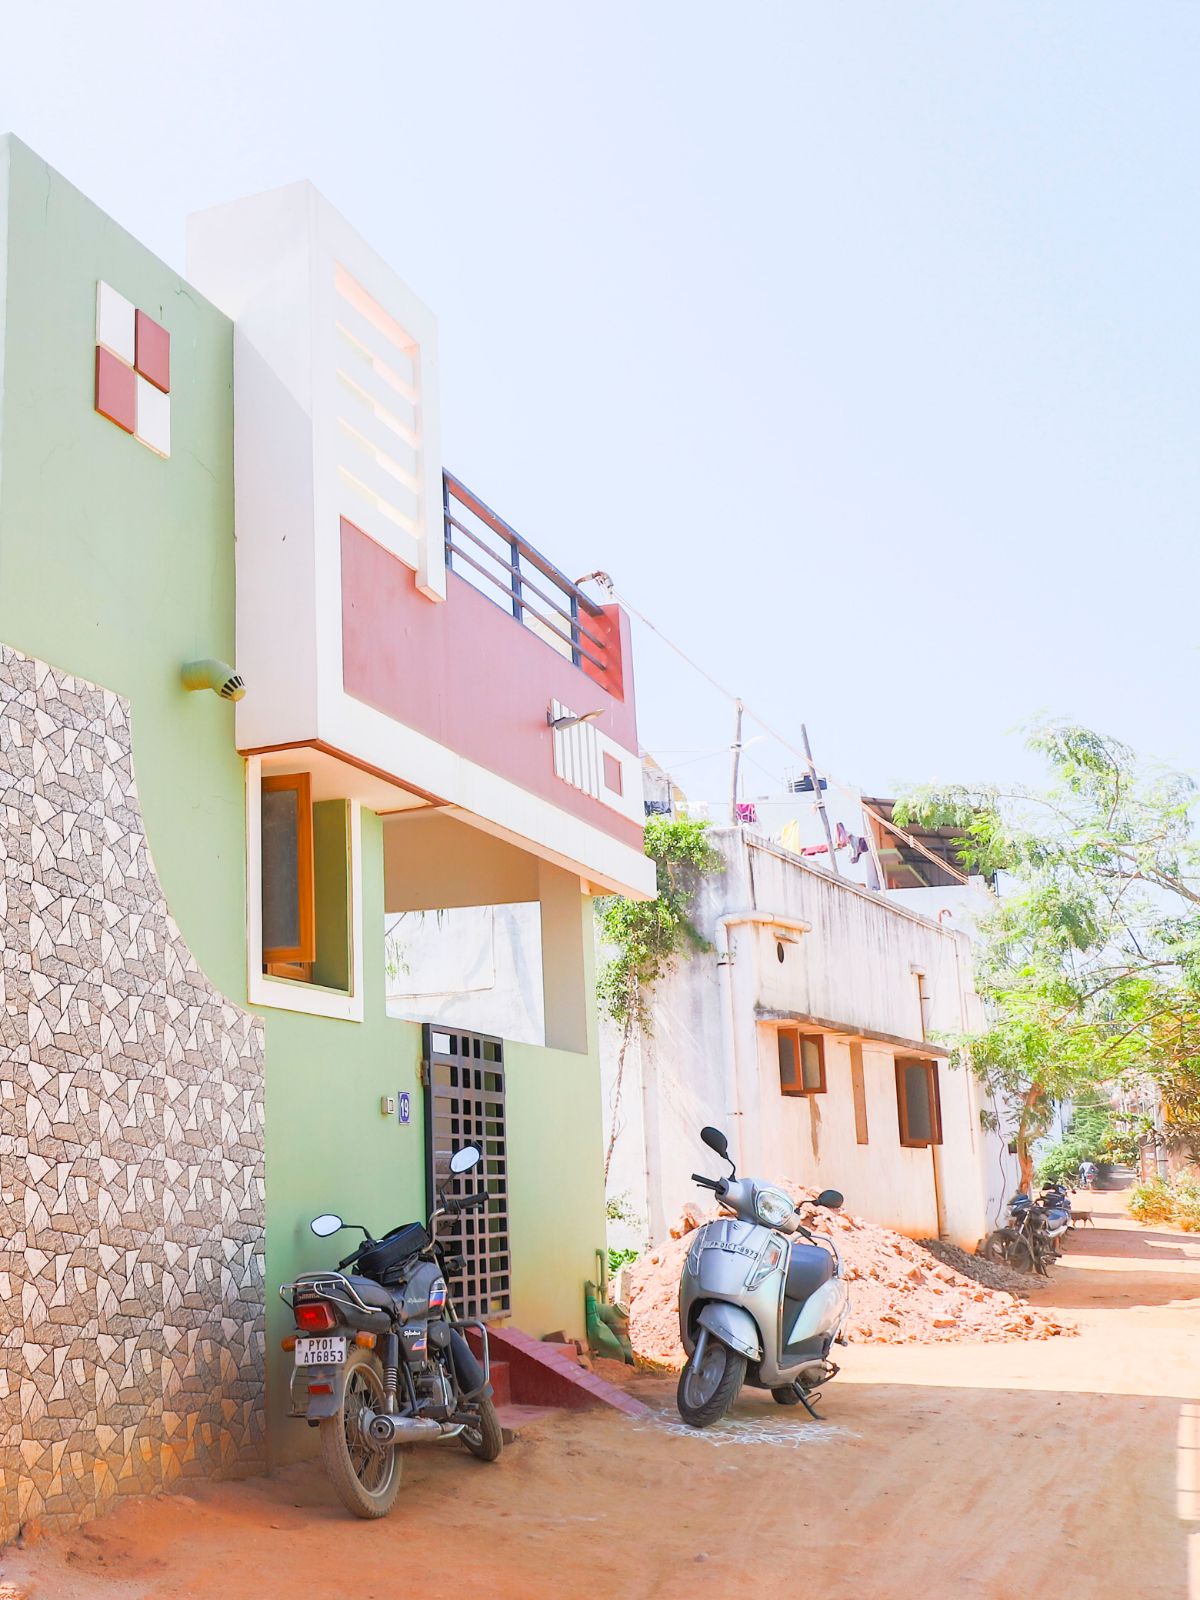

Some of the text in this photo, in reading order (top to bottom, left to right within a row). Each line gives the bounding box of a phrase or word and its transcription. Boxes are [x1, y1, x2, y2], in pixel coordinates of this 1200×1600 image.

[401, 1098, 409, 1118] 19
[308, 1338, 333, 1351] PY01
[304, 1350, 344, 1363] AT6853
